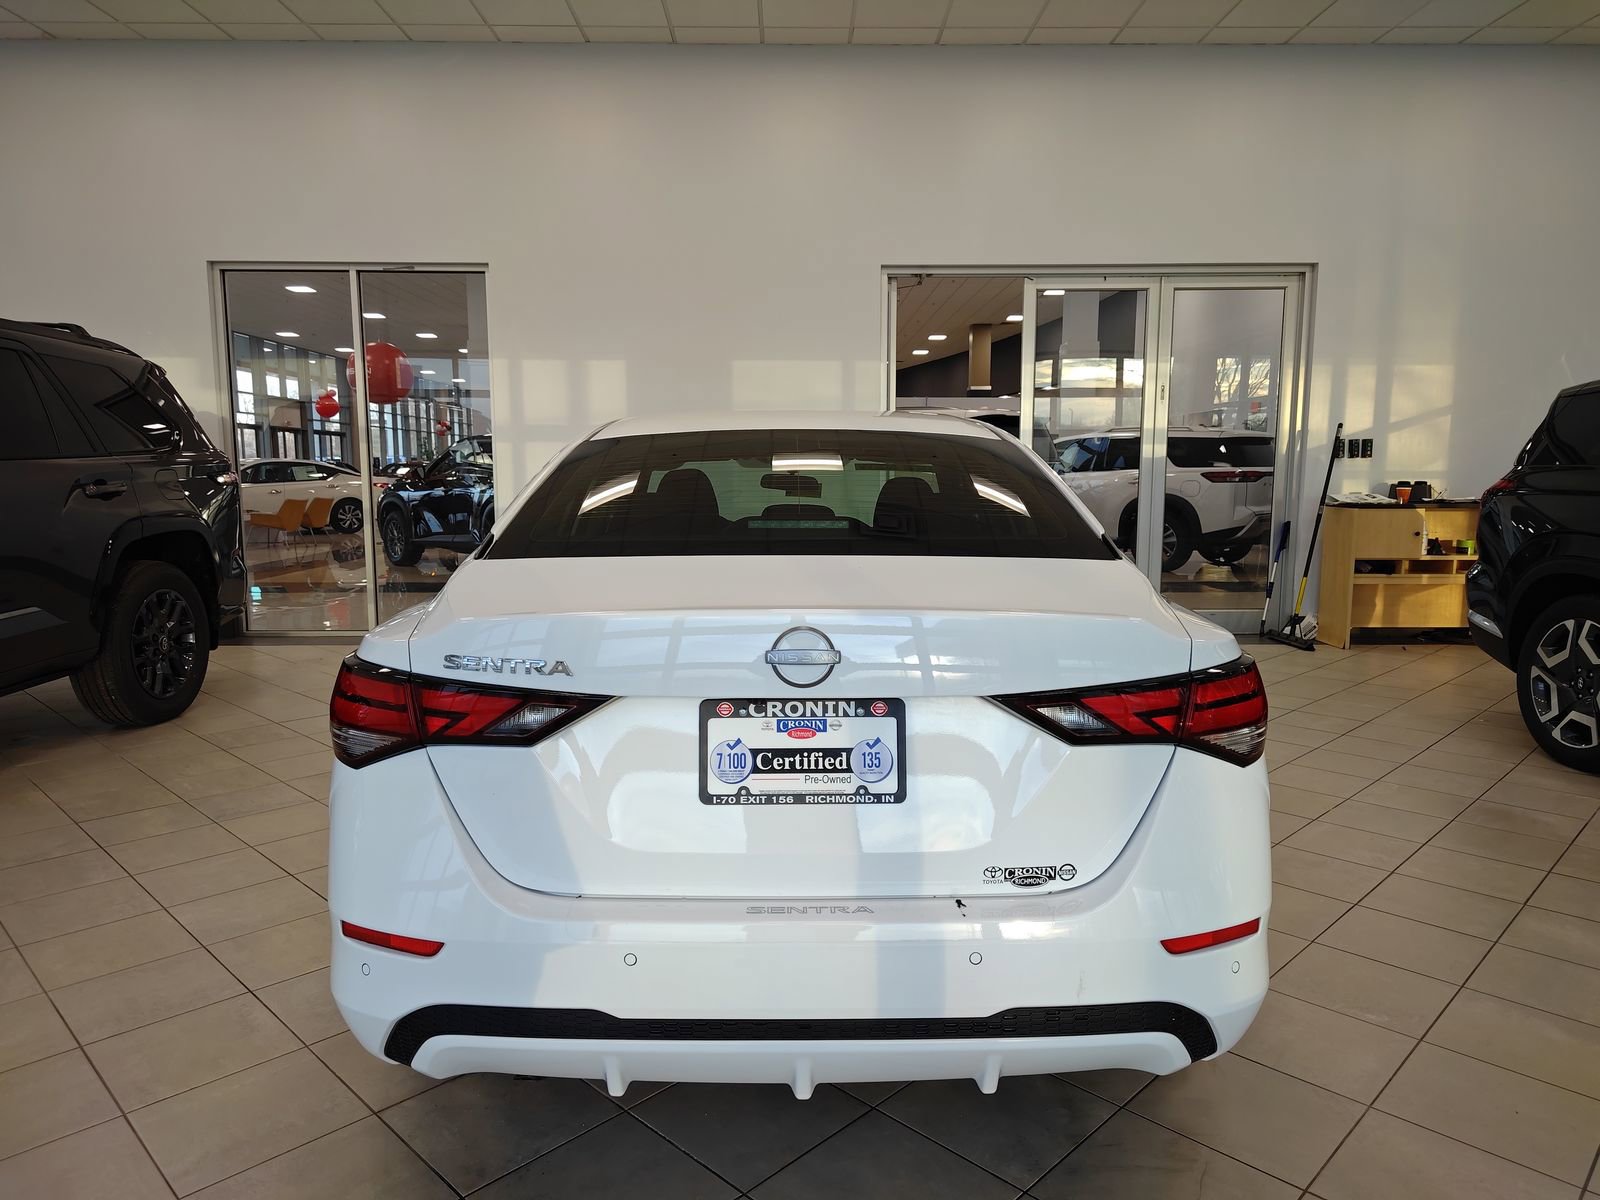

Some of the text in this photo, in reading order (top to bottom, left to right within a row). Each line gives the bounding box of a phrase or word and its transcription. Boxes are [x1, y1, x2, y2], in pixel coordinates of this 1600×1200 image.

[768, 653, 839, 662] NISSAN
[443, 654, 573, 677] SENTRA
[748, 701, 856, 717] CRONIN
[780, 720, 824, 732] CRONIN
[756, 752, 848, 770] Certified
[861, 751, 881, 768] 135
[804, 775, 852, 784] Pre-Owned
[713, 796, 736, 804] I-70
[740, 796, 767, 804] EXIT
[805, 795, 878, 803] RICHMOND,
[881, 795, 895, 803] IN
[1005, 867, 1056, 878] CRONIN
[1013, 877, 1046, 885] RICHMOND
[746, 906, 875, 914] SENTRA
